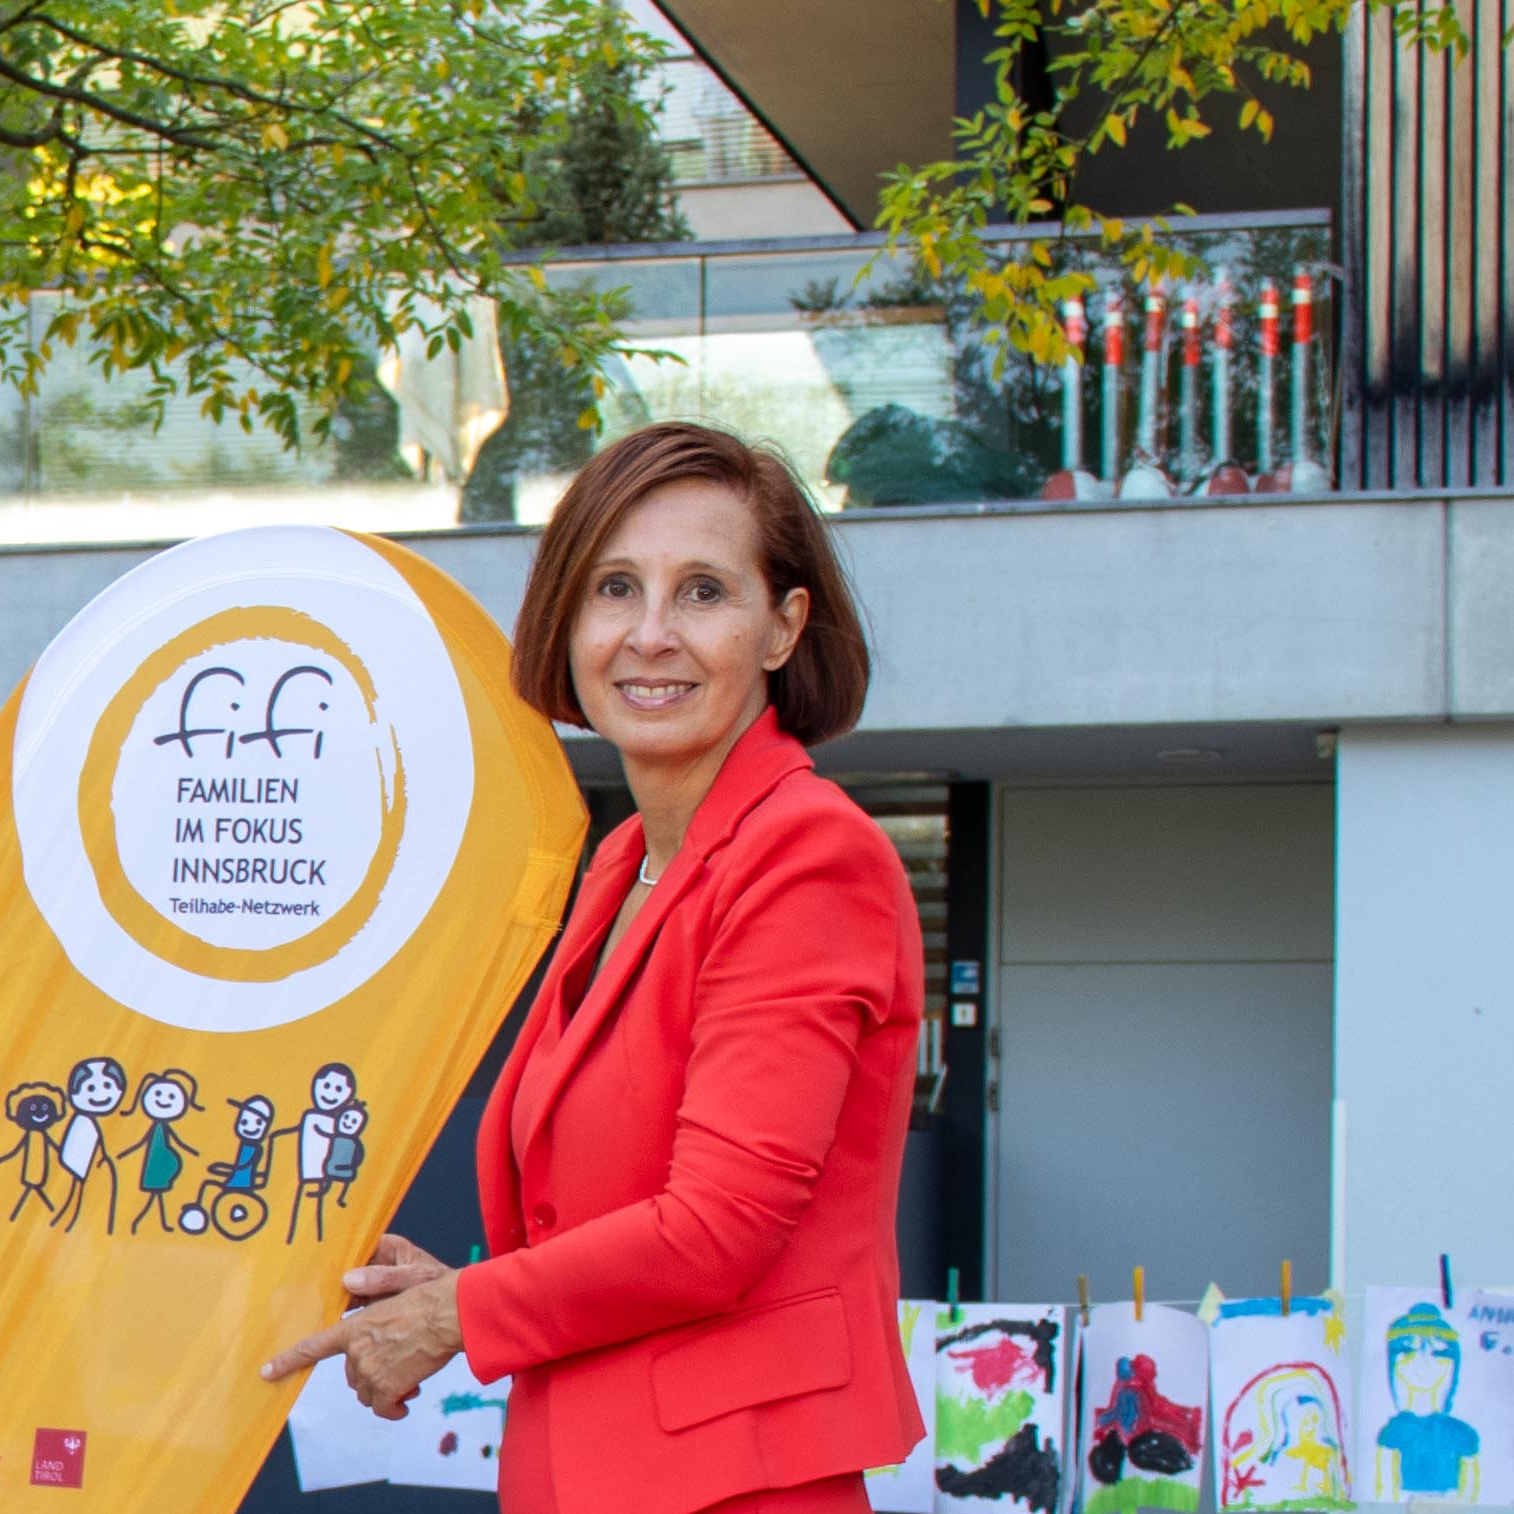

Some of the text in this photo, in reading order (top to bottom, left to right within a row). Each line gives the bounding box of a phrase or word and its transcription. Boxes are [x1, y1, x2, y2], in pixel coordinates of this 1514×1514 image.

[153, 665, 333, 759] fifi
[177, 778, 299, 804] FAMILIEN
[174, 818, 303, 845] IM FOKUS
[171, 857, 327, 887] INNSBRUCK
[169, 898, 320, 918] Teilhabe-Netzwerk
[34, 1471, 64, 1483] TIROL
[35, 1459, 64, 1473] LAND
